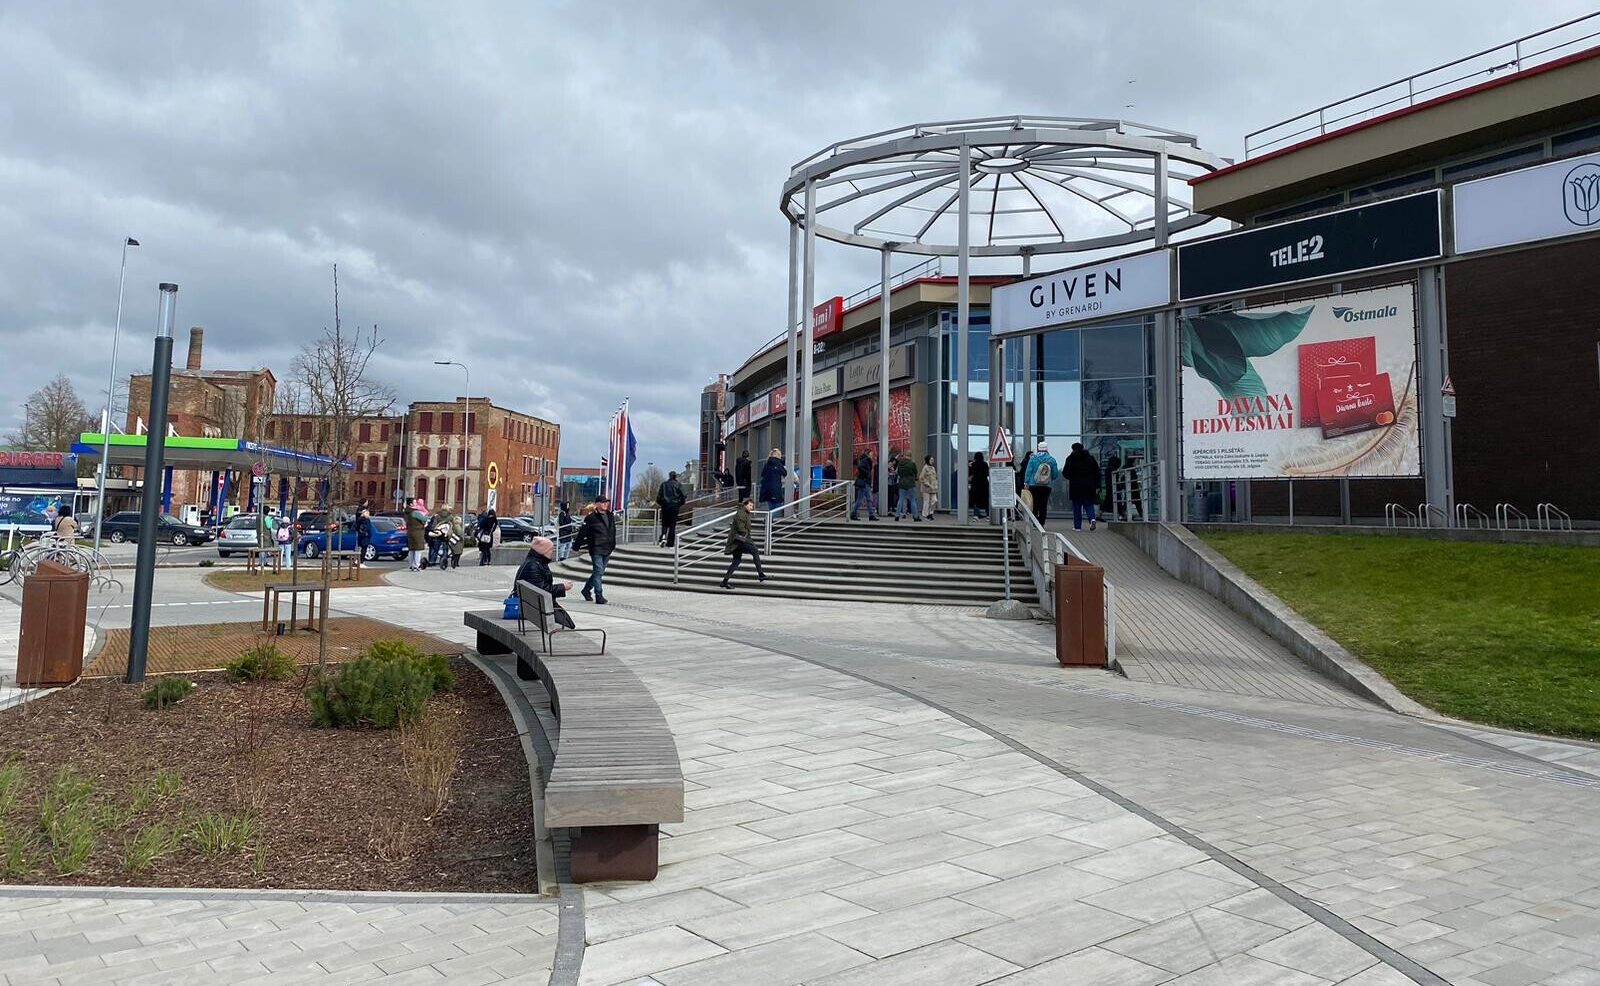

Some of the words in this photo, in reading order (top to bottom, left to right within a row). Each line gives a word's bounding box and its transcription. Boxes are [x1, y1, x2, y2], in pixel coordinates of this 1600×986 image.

[1270, 234, 1324, 267] TELE2
[1030, 267, 1121, 308] GIVEN
[813, 308, 828, 328] imi
[1046, 309, 1057, 319] BY
[1058, 301, 1102, 317] GRENARDI
[1344, 305, 1397, 322] Ostmala
[1218, 392, 1293, 415] DĀVANA
[1192, 413, 1293, 434] IEDVESMAI
[0, 452, 63, 468] BURGER
